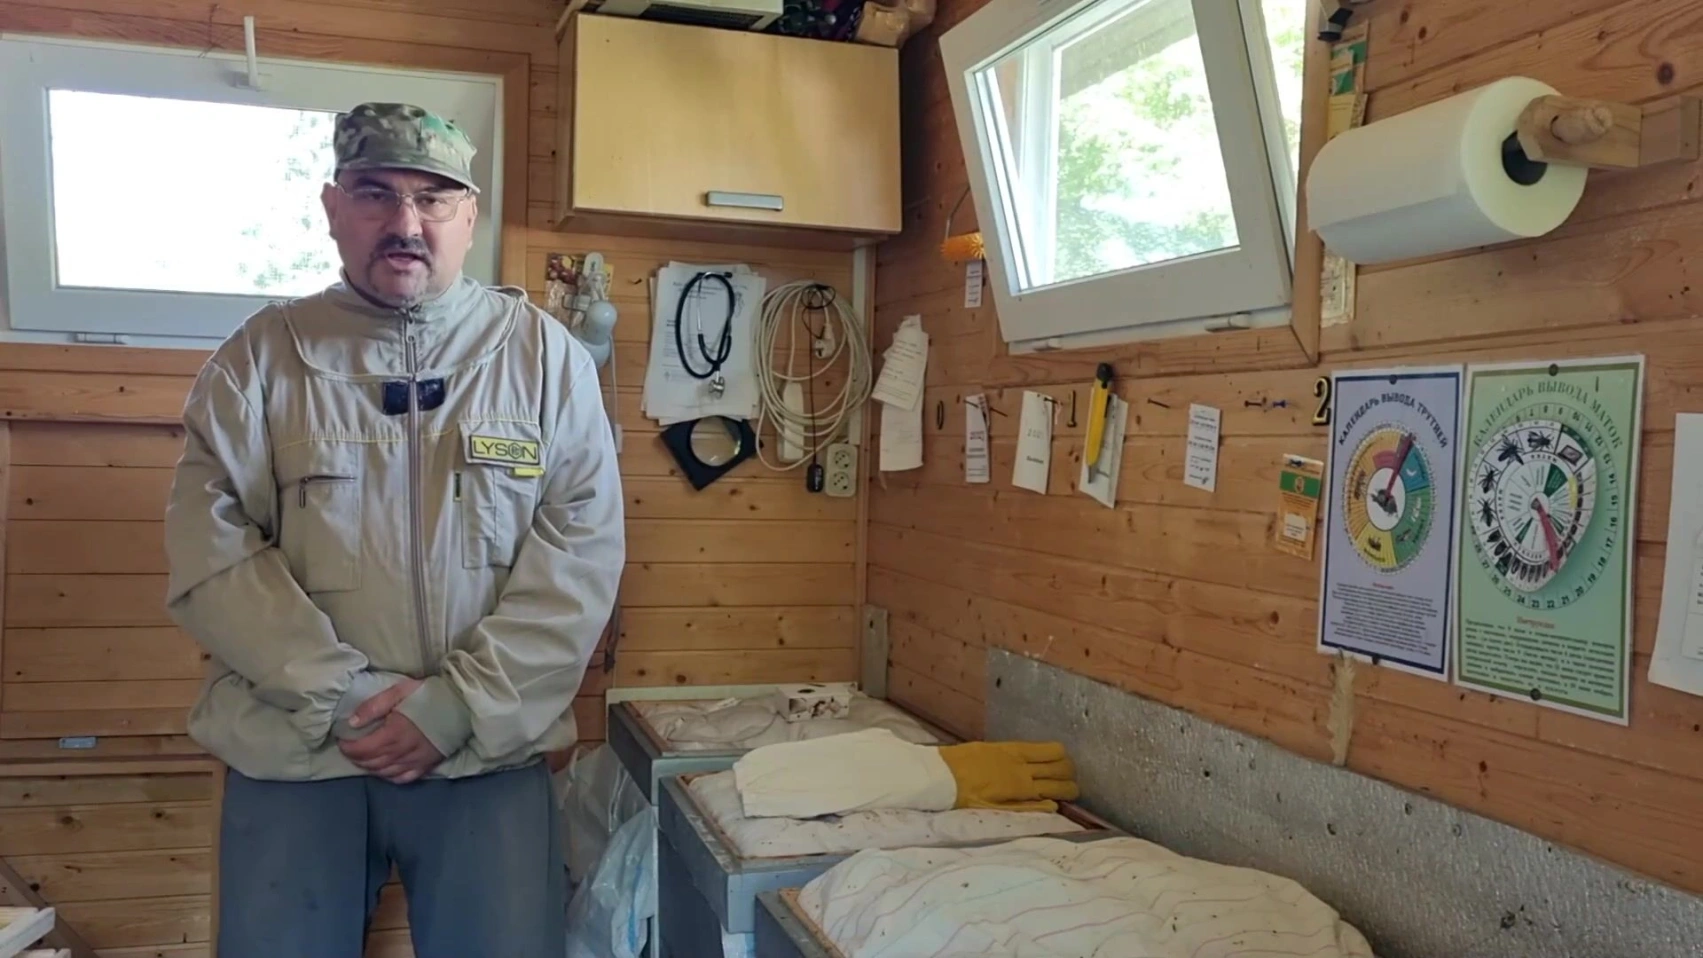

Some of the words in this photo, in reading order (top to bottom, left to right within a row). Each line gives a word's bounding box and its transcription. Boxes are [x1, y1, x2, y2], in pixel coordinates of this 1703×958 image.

[1312, 376, 1331, 425] 2
[1338, 397, 1380, 446] КАЛЕНДАРЬ
[1381, 392, 1415, 409] ВЫВОДА
[1416, 402, 1449, 449] ТРУТНЕЙ
[1537, 381, 1588, 405] ВЫВОДА
[1589, 399, 1624, 449] МАТОК
[473, 440, 537, 460] LYSON
